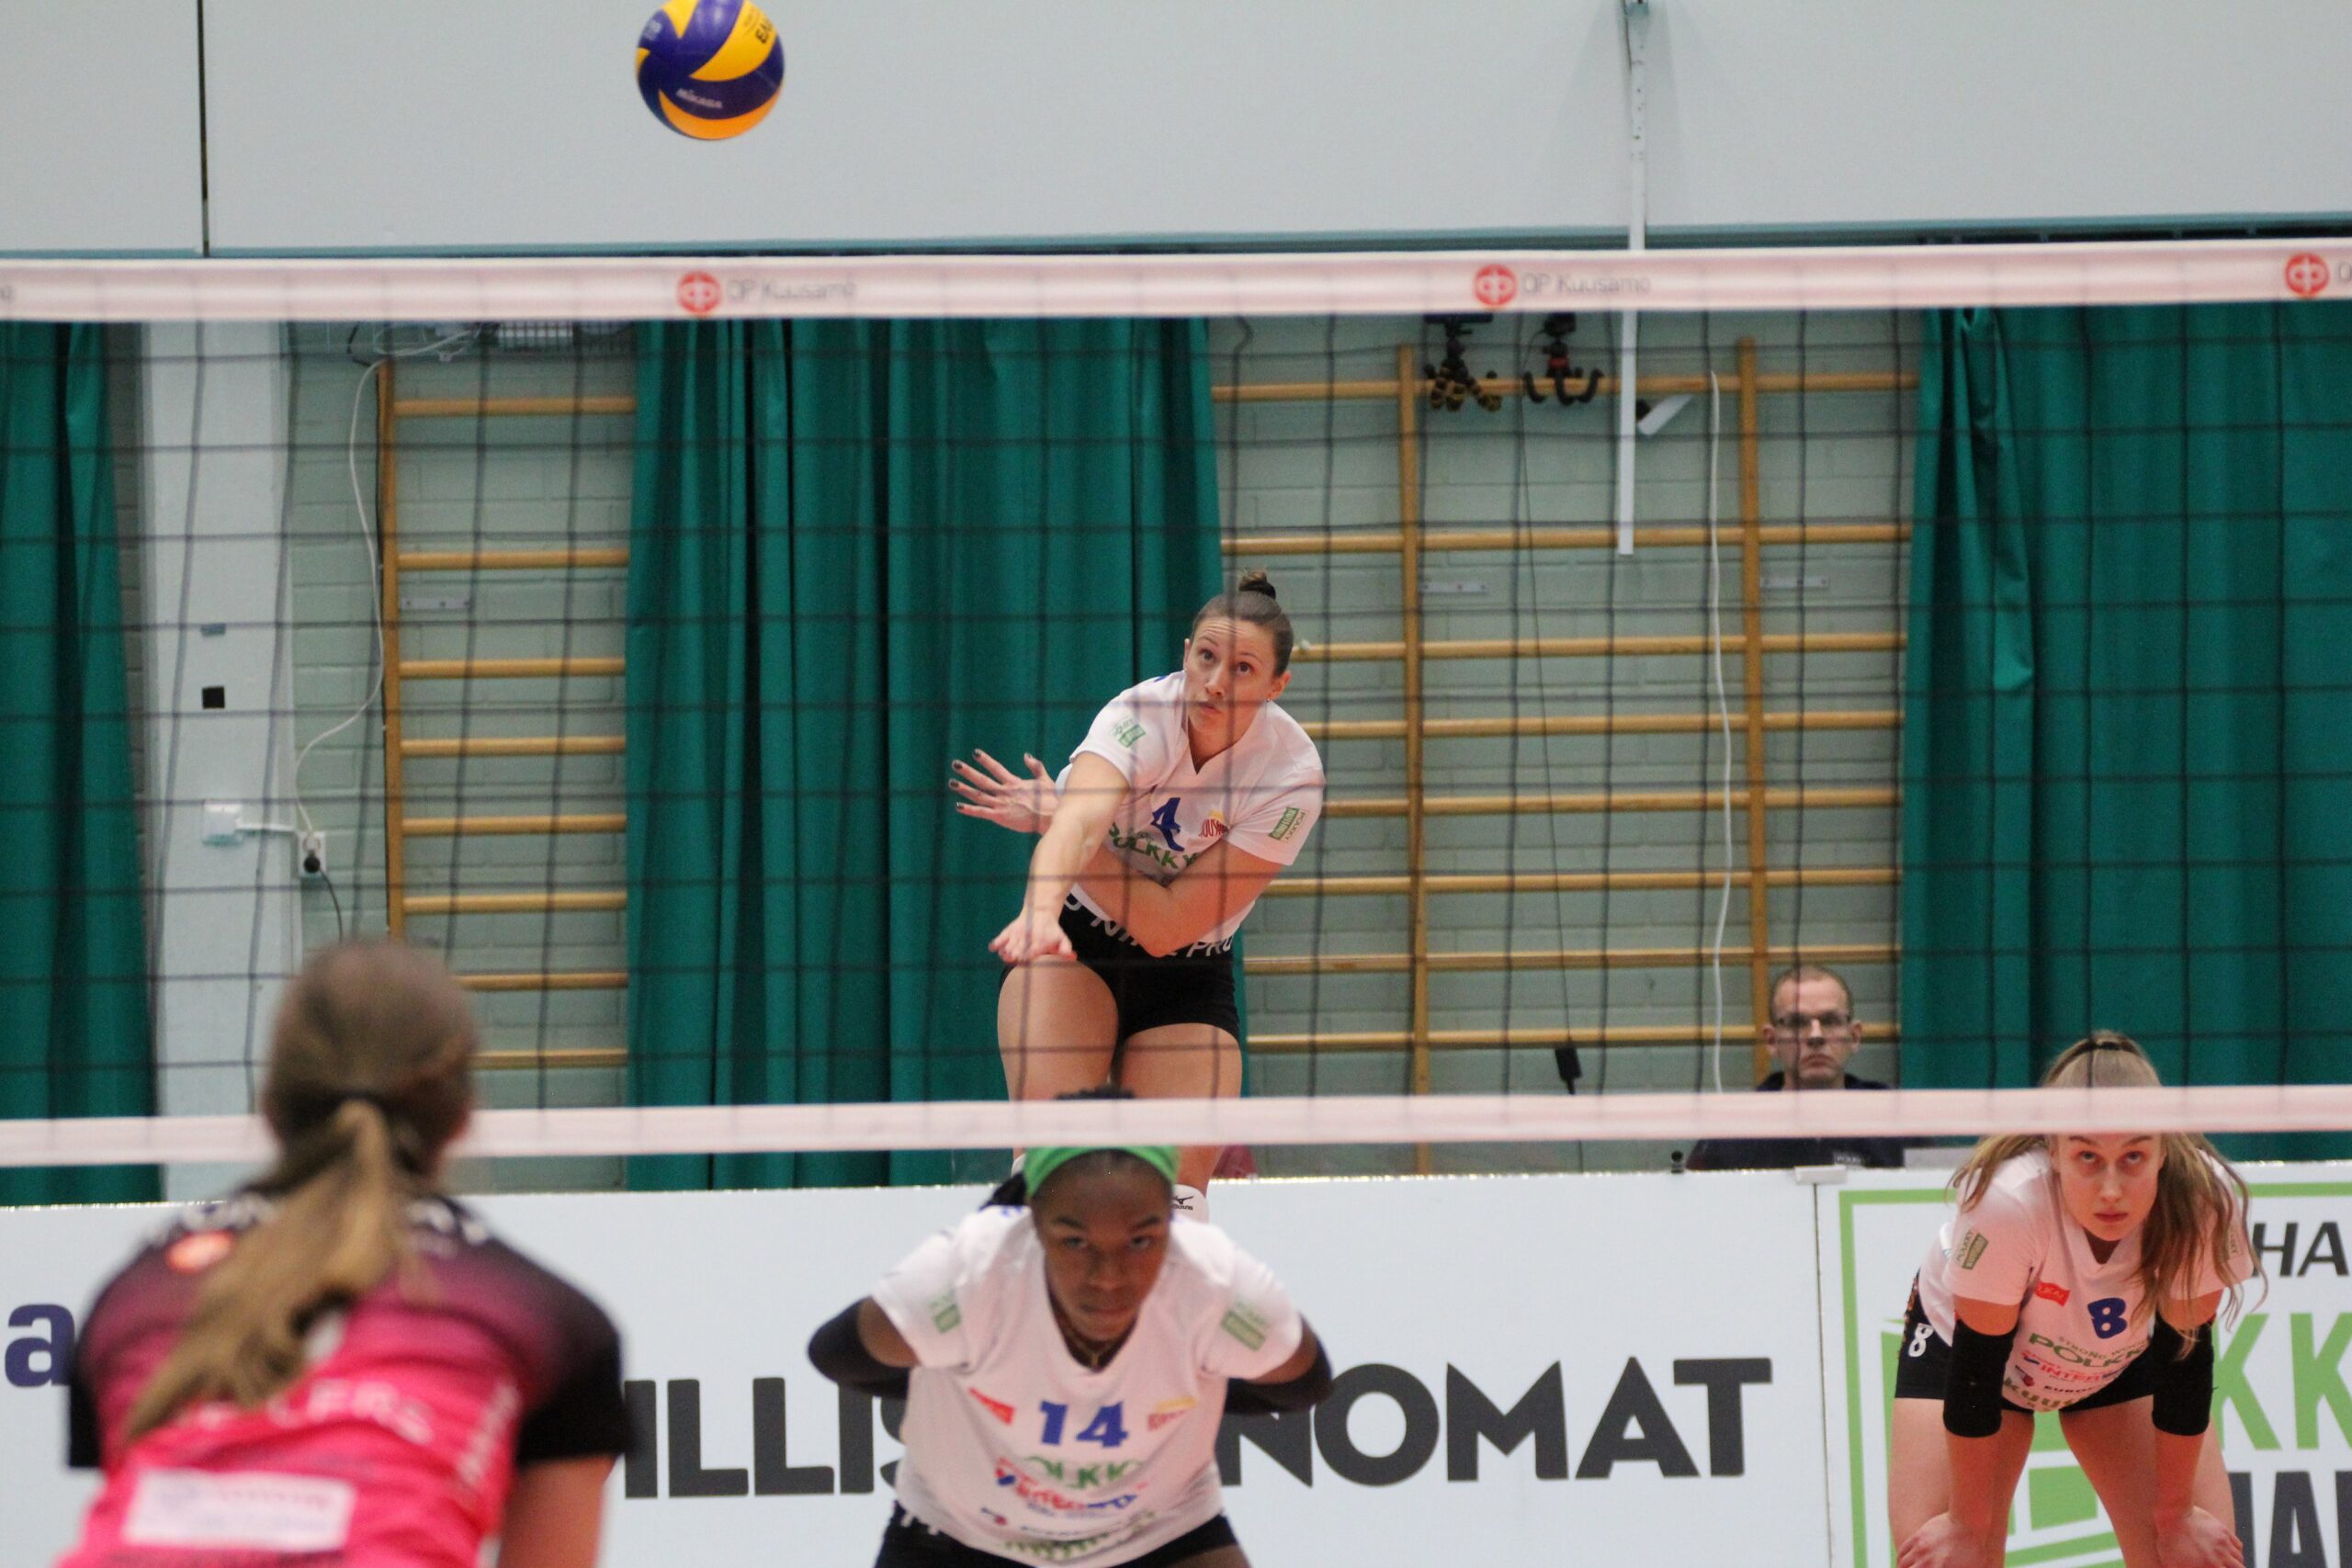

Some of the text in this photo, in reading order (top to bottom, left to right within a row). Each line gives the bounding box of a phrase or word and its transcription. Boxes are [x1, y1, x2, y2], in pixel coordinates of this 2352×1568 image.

[1150, 797, 1185, 852] 4
[2087, 1297, 2128, 1339] 8
[1908, 1323, 1934, 1358] 8
[1040, 1401, 1128, 1448] 14
